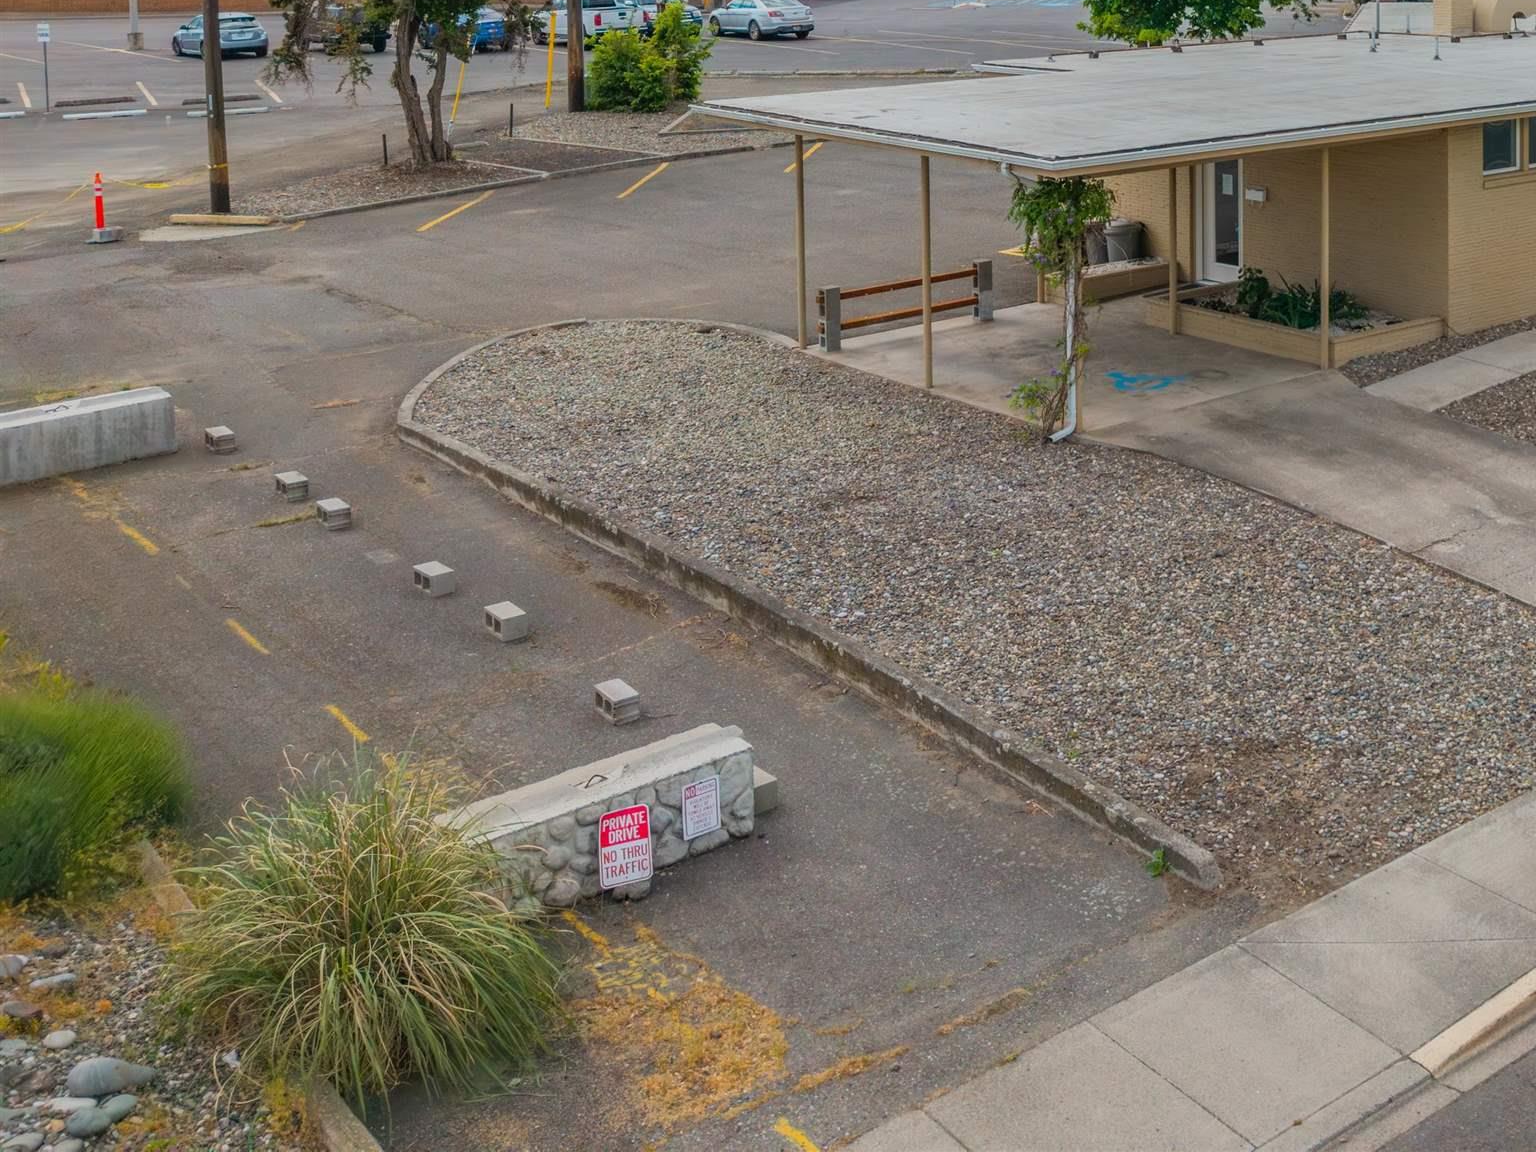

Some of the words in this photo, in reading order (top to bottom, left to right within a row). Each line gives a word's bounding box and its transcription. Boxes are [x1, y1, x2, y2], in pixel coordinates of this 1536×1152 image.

[685, 786, 696, 799] NO
[602, 811, 646, 832] PRIVATE
[608, 825, 641, 845] DRIVE
[603, 850, 618, 865] NO
[622, 844, 648, 861] THRU
[604, 859, 648, 879] TRAFFIC
